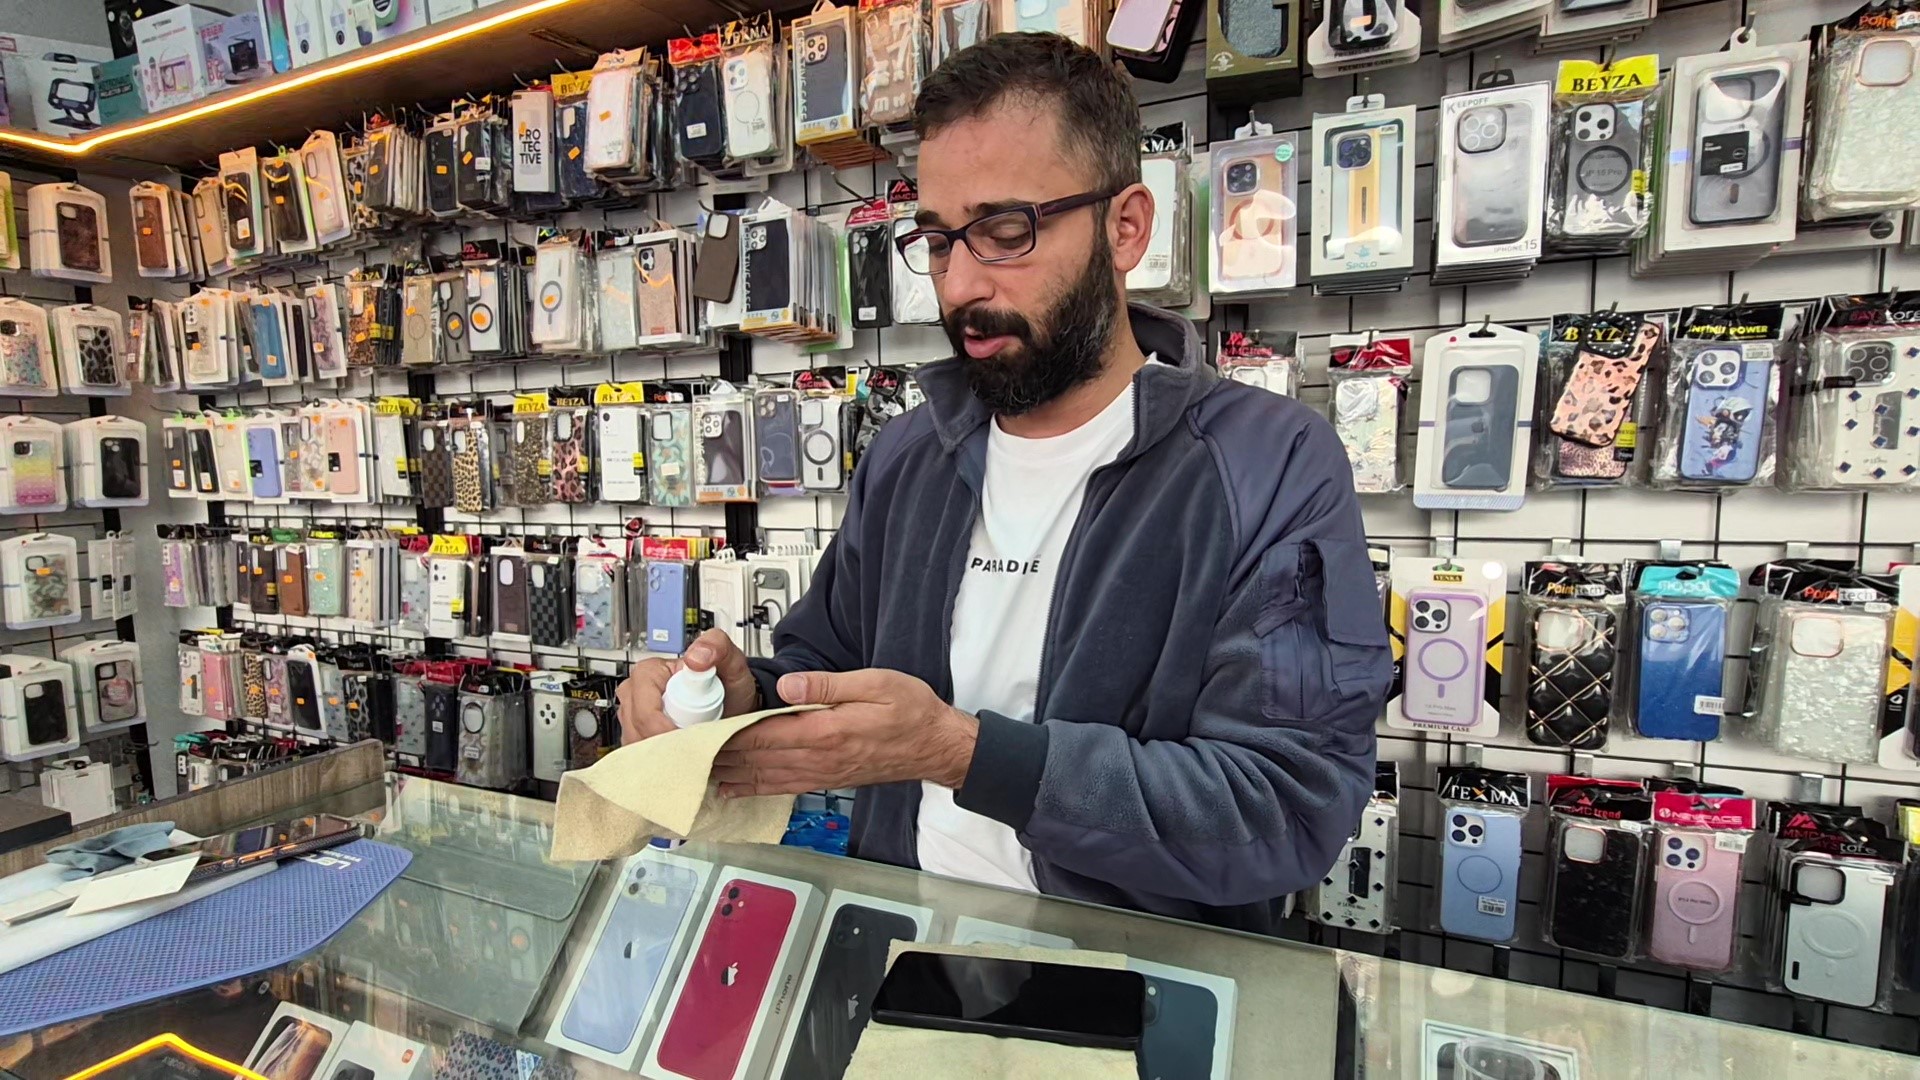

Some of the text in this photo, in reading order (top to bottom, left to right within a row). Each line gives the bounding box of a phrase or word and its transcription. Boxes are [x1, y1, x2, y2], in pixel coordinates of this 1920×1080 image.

[1571, 73, 1642, 92] BEYZA
[522, 141, 541, 152] TEC
[519, 153, 541, 164] TIVE
[1524, 239, 1537, 250] 15
[1345, 261, 1378, 270] SPOLO
[1565, 326, 1629, 342] BYZA
[517, 402, 545, 412] BEYZA
[1413, 722, 1449, 730] PREMIUM
[1451, 785, 1520, 806] TEXMA
